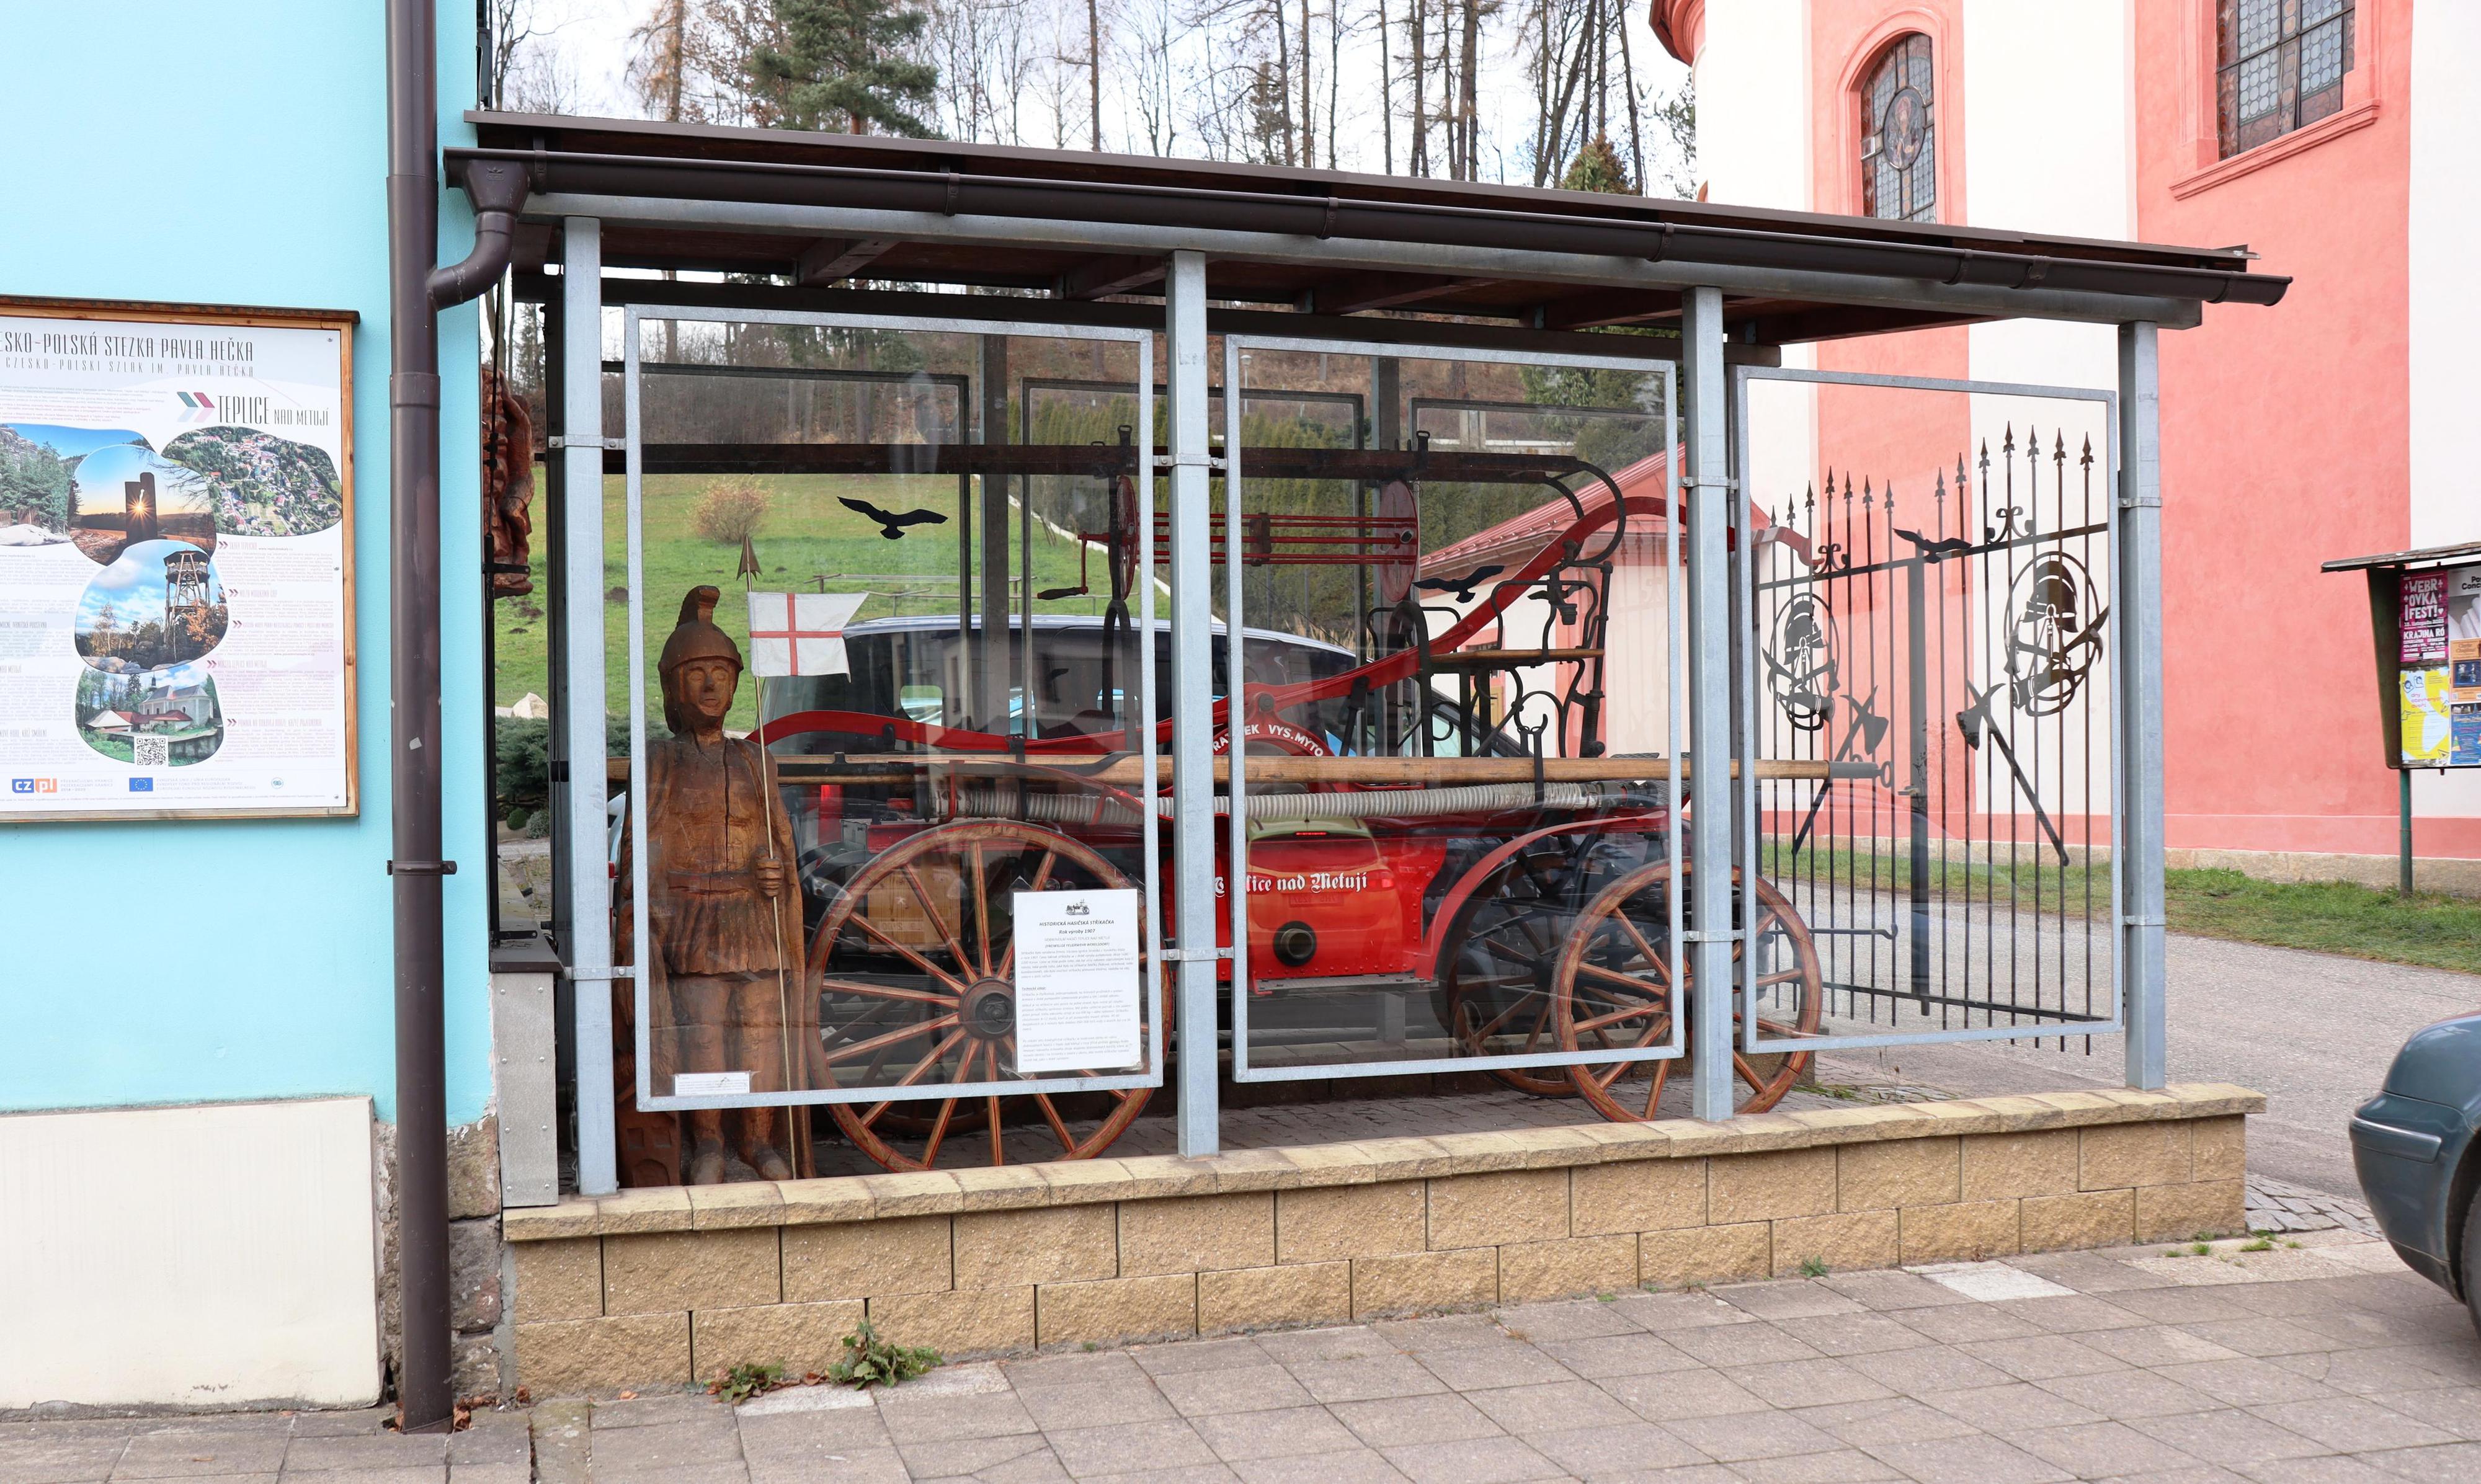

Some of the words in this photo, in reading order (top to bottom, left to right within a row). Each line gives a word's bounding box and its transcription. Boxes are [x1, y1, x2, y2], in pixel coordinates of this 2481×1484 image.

[105, 336, 154, 358] STEZKA
[161, 338, 203, 360] PAVLA
[211, 337, 253, 362] HEČKA
[6, 357, 100, 371] CZESKO-POLSKI
[109, 361, 143, 373] SZLAK
[177, 363, 211, 376] PAVLA
[218, 396, 270, 424] TEPLICE
[274, 408, 292, 425] NAD
[296, 407, 329, 426] METUJÍ
[2408, 578, 2438, 593] WEBR
[2408, 592, 2438, 606] OVKA
[2409, 605, 2438, 620] FEST!
[2403, 629, 2434, 640] KRAJINA
[1276, 873, 1305, 891] nad
[1310, 872, 1368, 894] Metují
